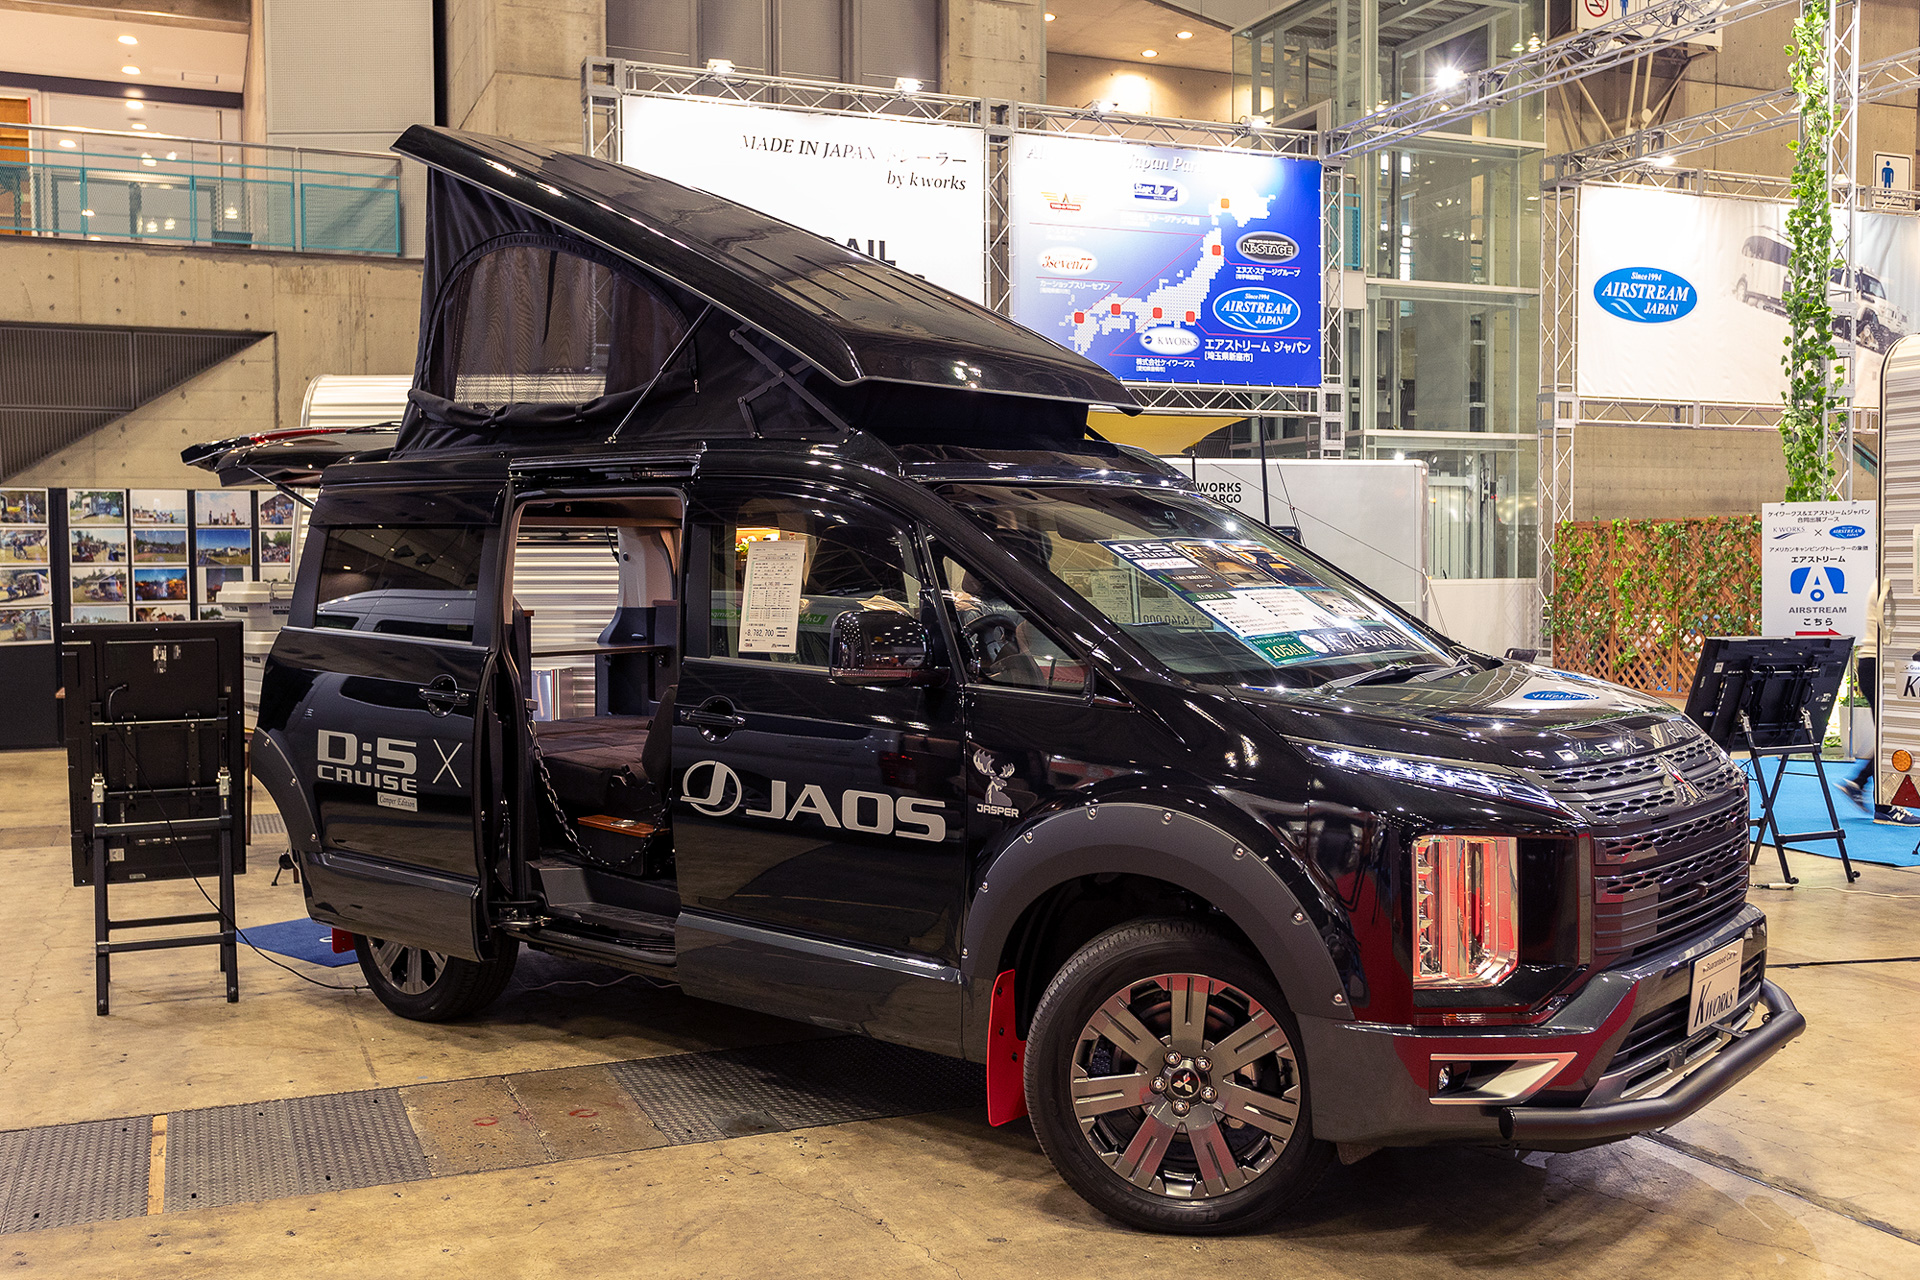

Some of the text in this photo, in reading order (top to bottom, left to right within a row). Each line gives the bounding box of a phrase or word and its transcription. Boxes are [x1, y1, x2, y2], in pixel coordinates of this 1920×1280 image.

[798, 139, 820, 155] IN
[887, 170, 905, 188] by
[1601, 281, 1690, 302] AIRSTREAM
[1221, 300, 1293, 315] AIRSTREAM
[1644, 302, 1679, 315] JAPAN
[1255, 315, 1284, 326] JAPAN
[1204, 338, 1312, 354] エアストリーム ジャパン
[1197, 482, 1242, 493] WORKS
[1788, 606, 1847, 614] AIRSTREAM
[1803, 617, 1833, 626] こちら
[1265, 643, 1311, 659] 105Ah
[317, 729, 417, 775] D:5
[317, 764, 418, 794] CRUISE
[746, 780, 946, 843] JAOS
[976, 803, 1019, 818] JASPER
